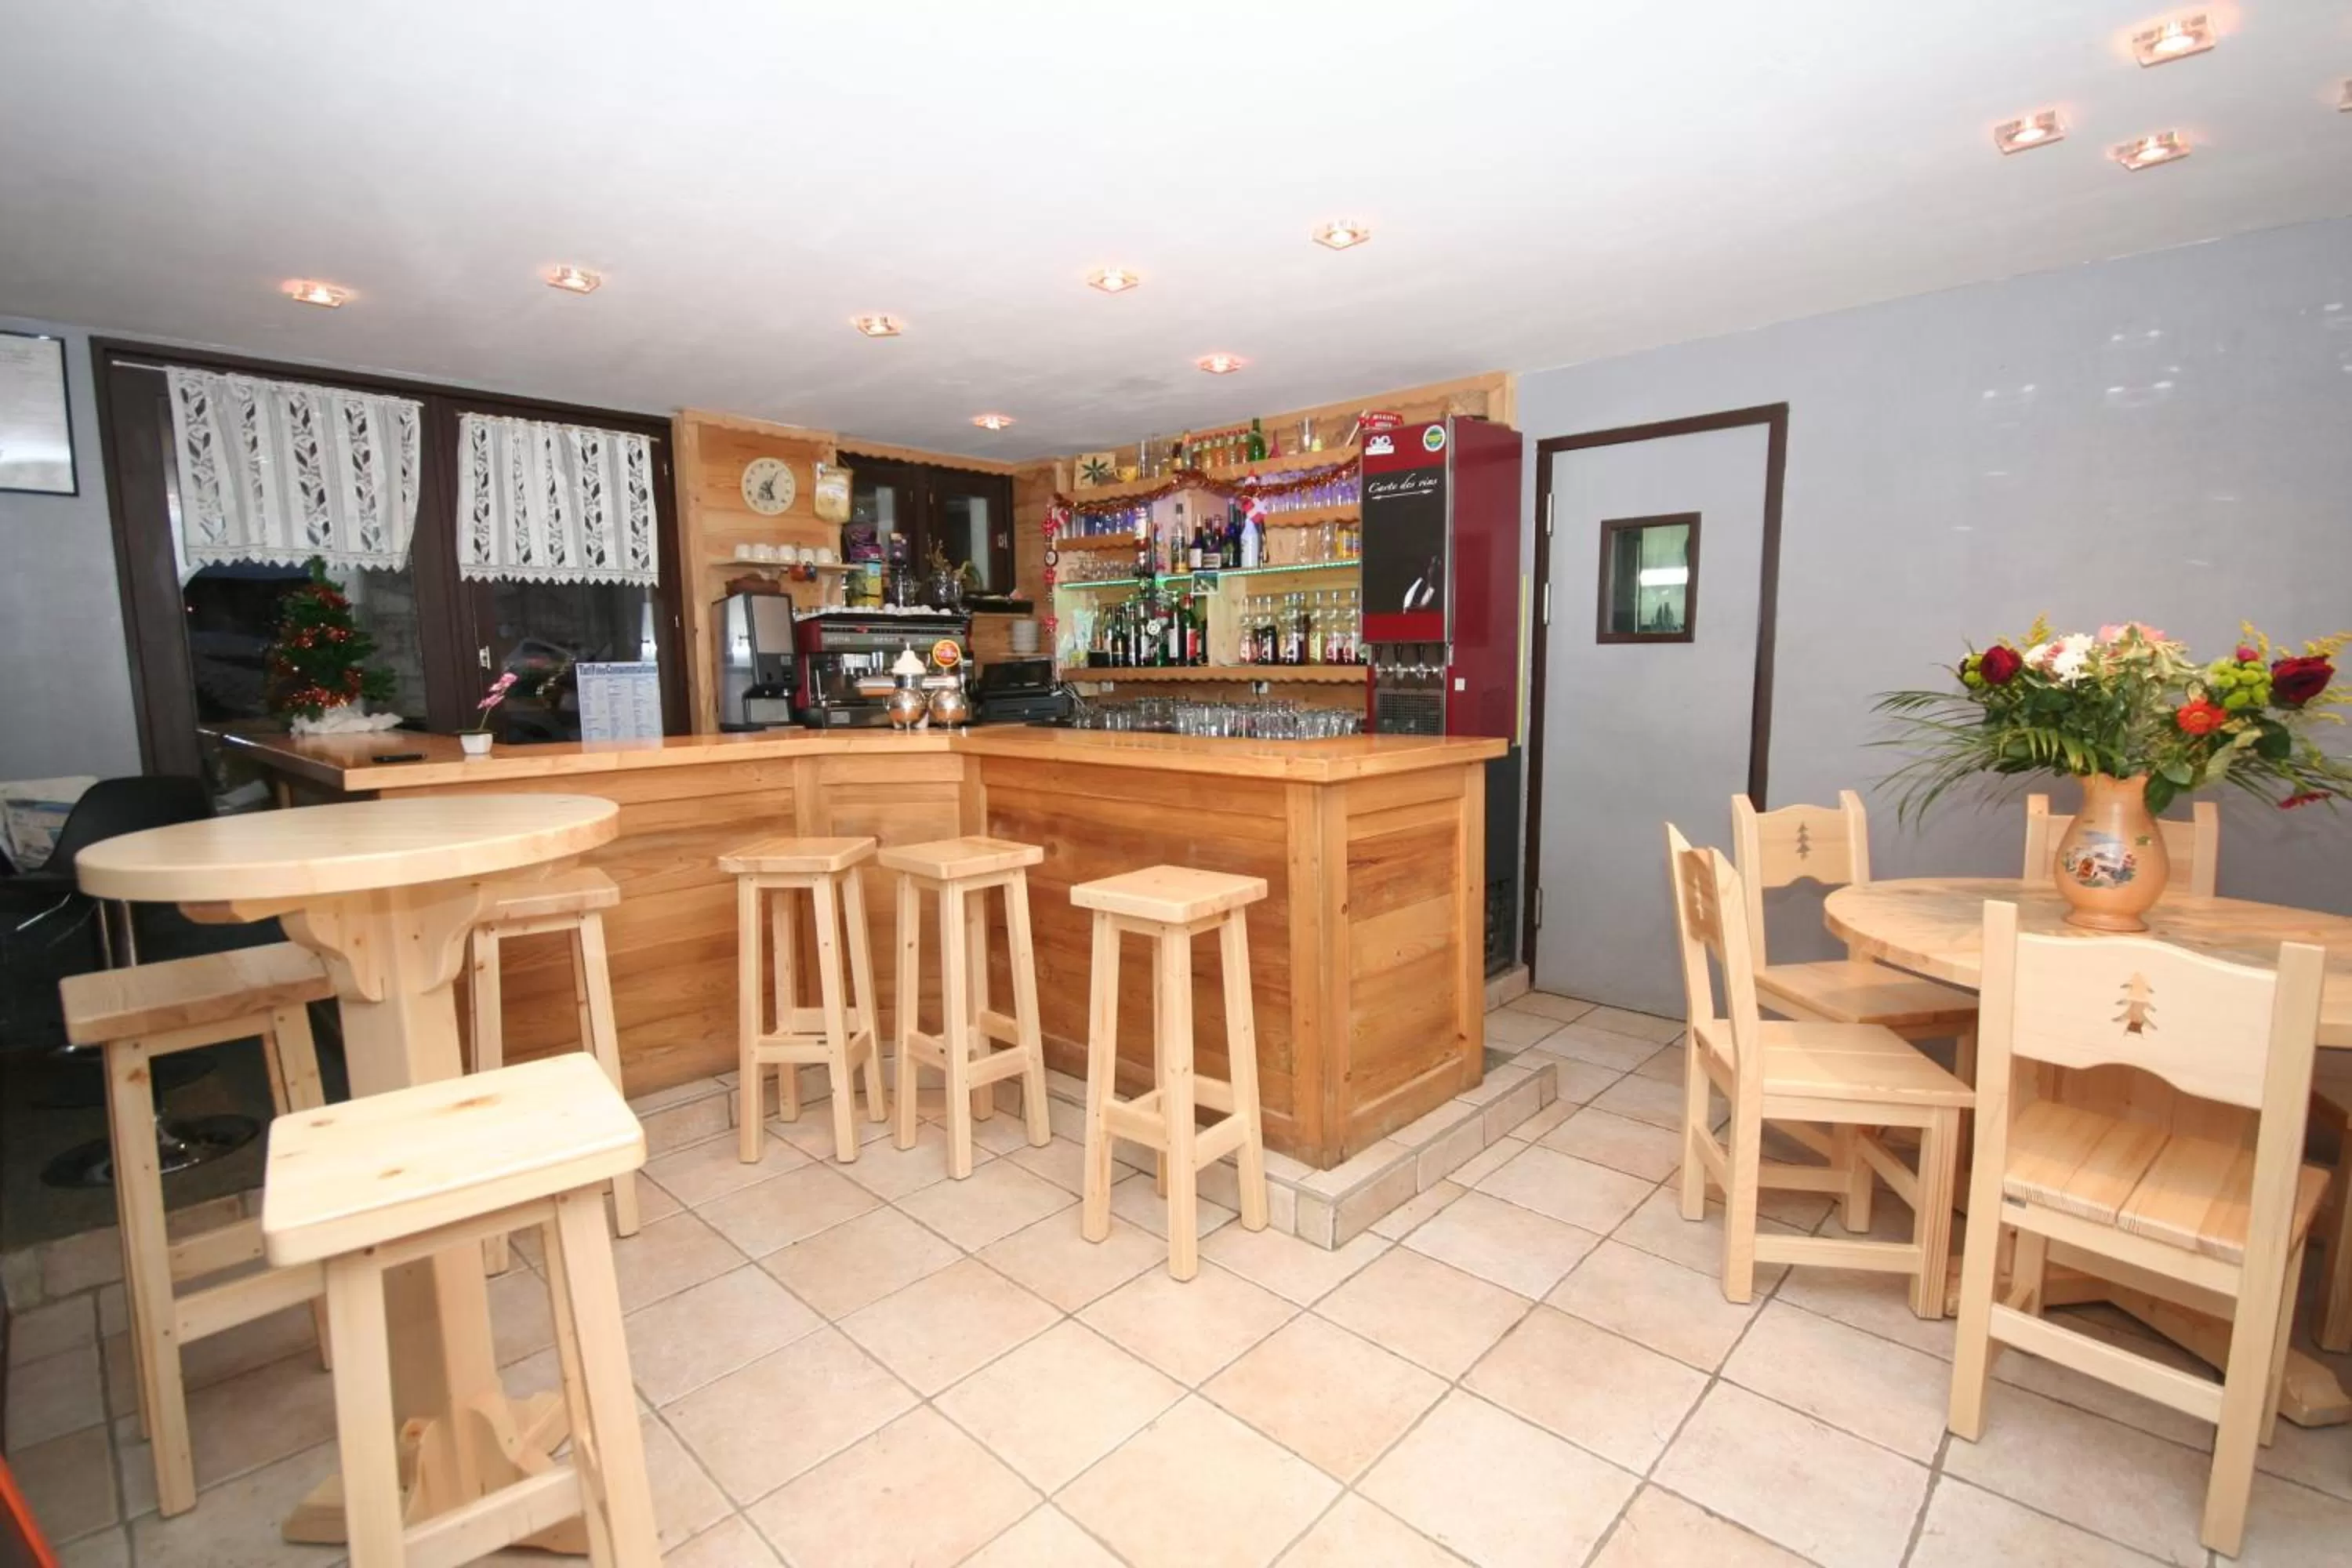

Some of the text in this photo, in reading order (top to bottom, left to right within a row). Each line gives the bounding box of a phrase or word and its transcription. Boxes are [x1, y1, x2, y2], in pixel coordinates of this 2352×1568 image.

[1368, 472, 1439, 493] Carte des vins
